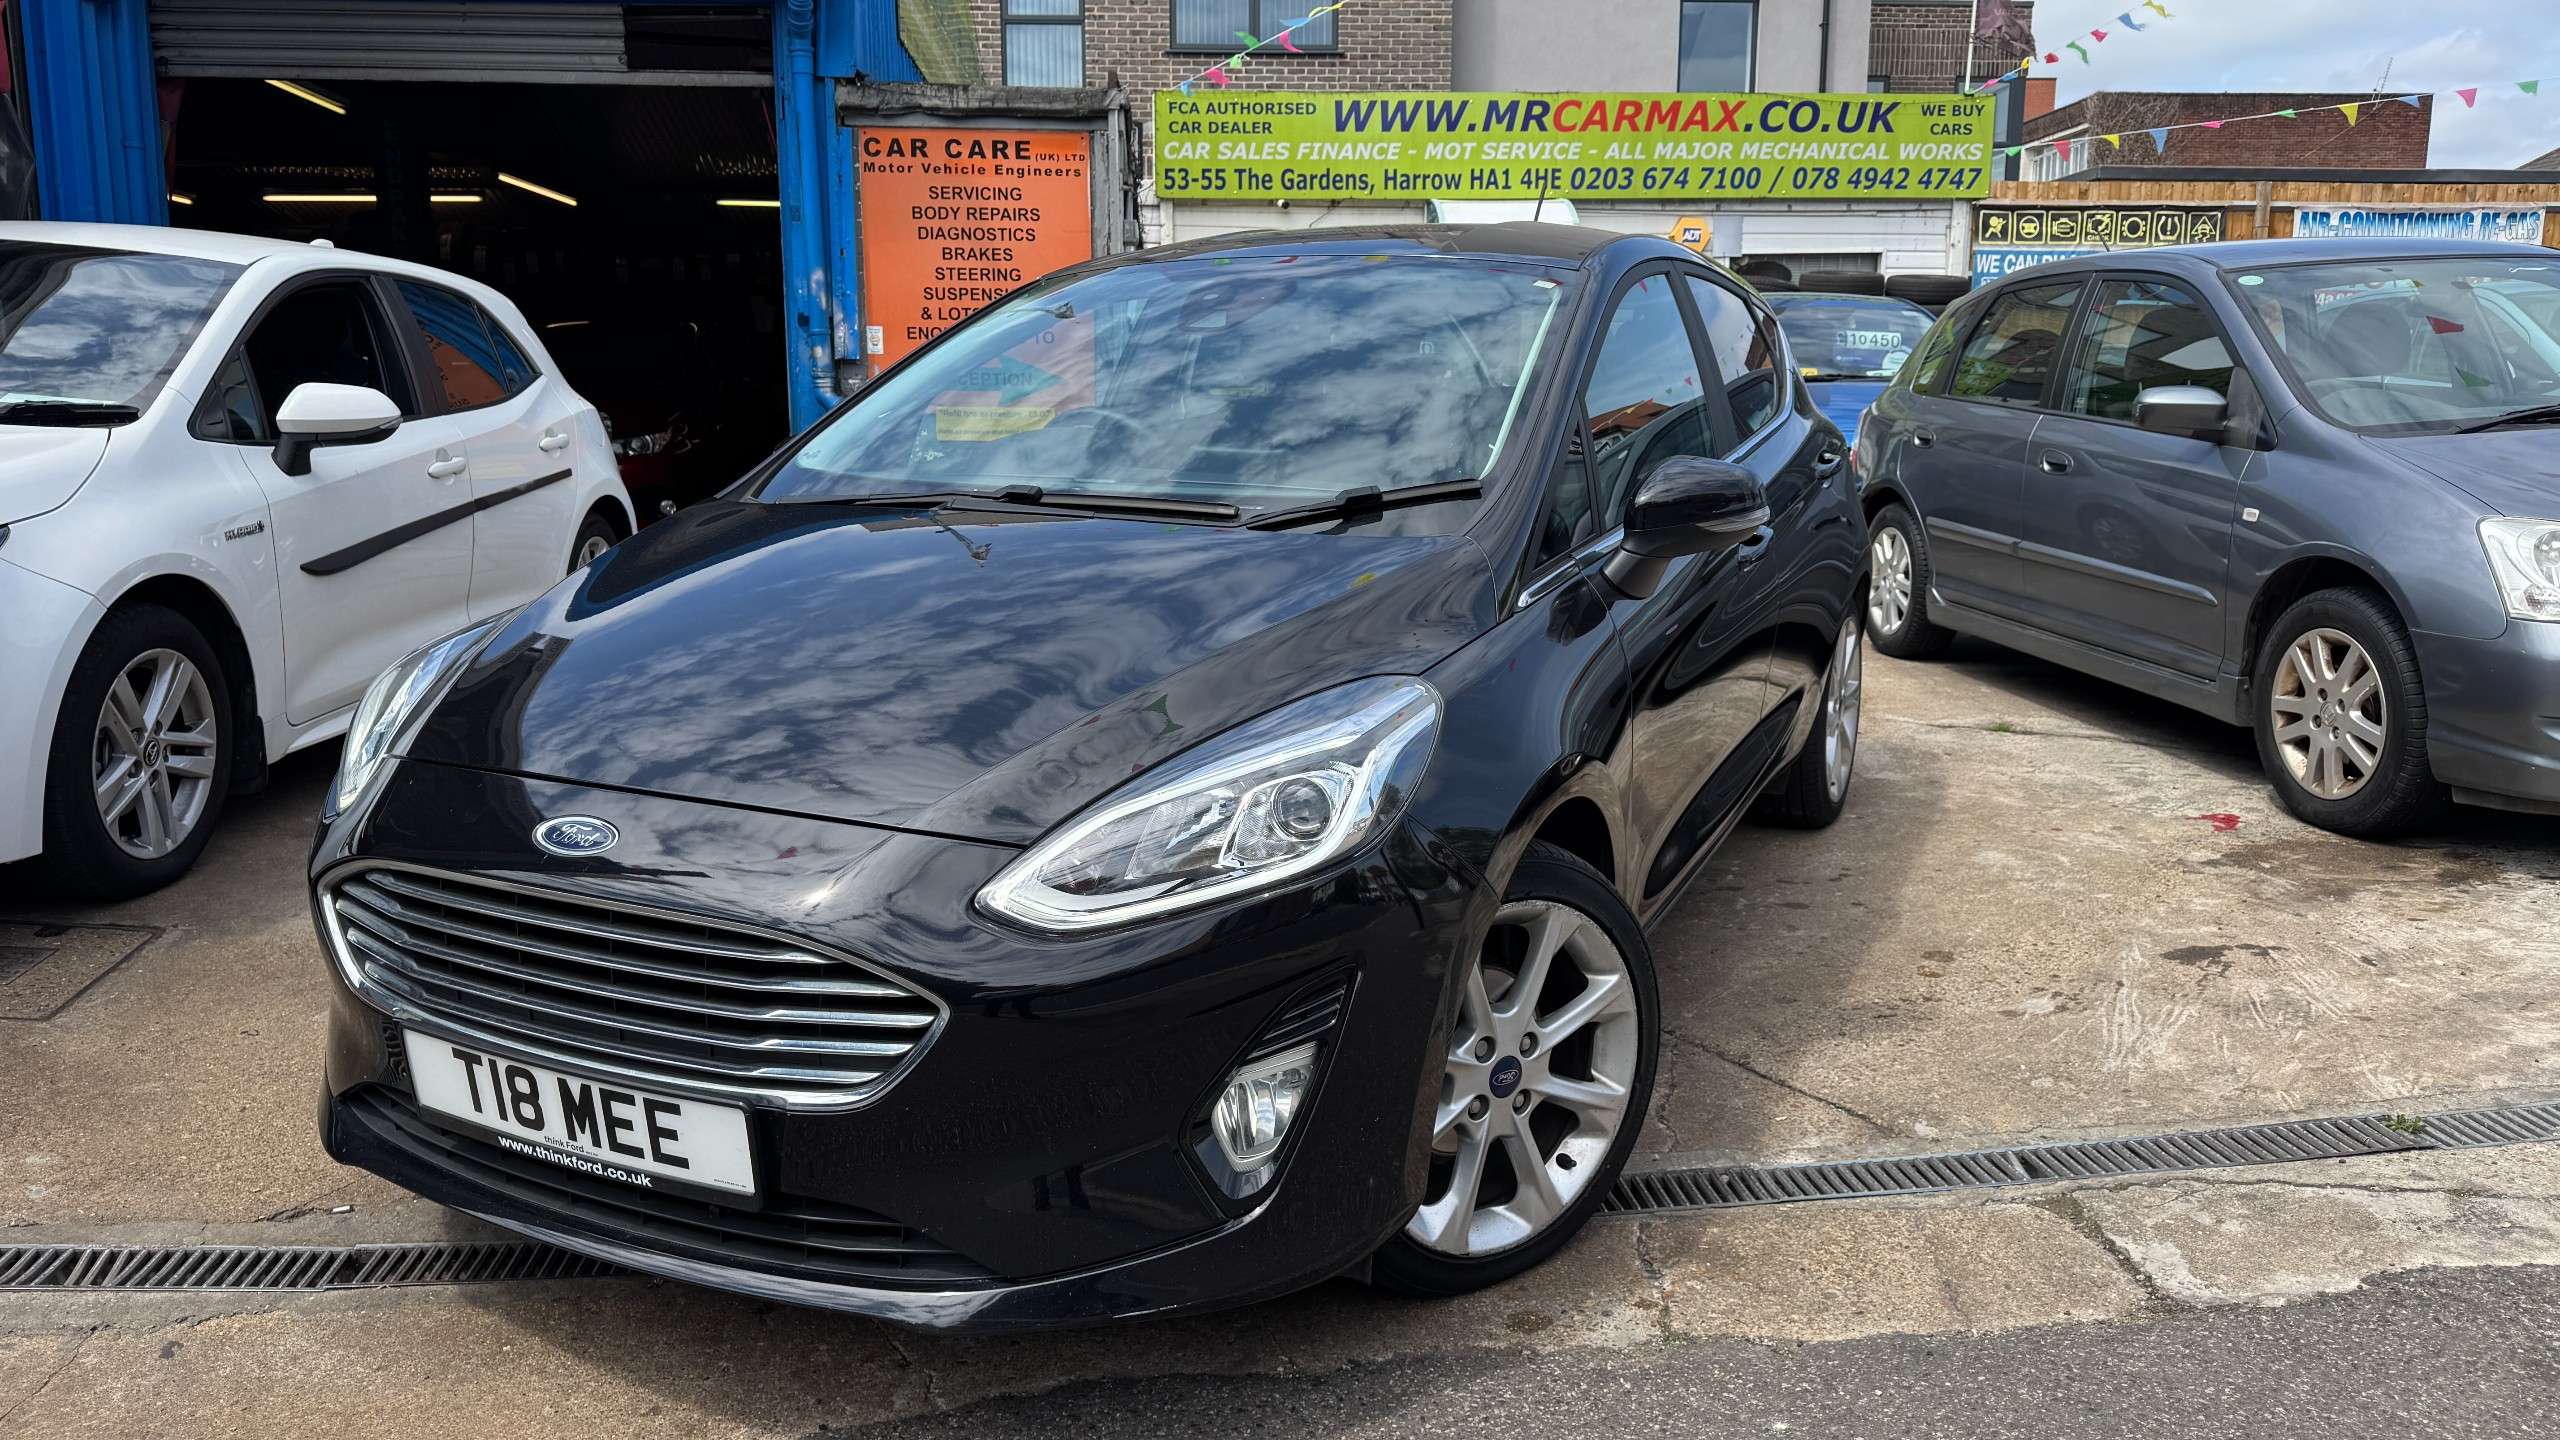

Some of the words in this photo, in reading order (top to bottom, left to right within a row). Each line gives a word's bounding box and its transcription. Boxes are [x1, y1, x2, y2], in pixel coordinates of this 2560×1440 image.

[1168, 101, 1199, 115] FCA
[1205, 101, 1317, 116] AUTHORISED
[1333, 99, 1901, 134] WWW.MRCARMAX.CO.UK
[1921, 103, 1947, 117] WE
[1951, 103, 1985, 118] BUY
[1168, 120, 1203, 135] CAR
[1207, 120, 1273, 135] DEALER
[1930, 122, 1973, 136] CARS
[863, 136, 929, 158] CAR
[944, 138, 1032, 161] CARE
[1035, 153, 1060, 163] (UK)
[1065, 153, 1086, 162] LTD
[1163, 141, 1210, 161] CAR
[1216, 141, 1291, 161] SALES
[1296, 141, 1401, 161] FINANCE
[1424, 141, 1477, 161] MOT
[1481, 141, 1582, 161] SERVICE
[1604, 141, 1646, 161] ALL
[1653, 141, 1734, 161] MAJOR
[1739, 141, 1890, 161] MECHANICAL
[1900, 141, 1984, 161] WORKS
[863, 161, 913, 174] Motor
[922, 162, 986, 176] Vehicle
[994, 164, 1082, 179] Engineers
[1163, 167, 1227, 192] 53-55
[1234, 167, 1274, 192] The
[1280, 167, 1376, 195] Gardens,
[1383, 168, 1462, 191] Harrow
[1470, 167, 1512, 191] HA1
[1520, 167, 1561, 191] 4HE
[1570, 166, 1634, 191] 0203
[1642, 166, 1689, 190] 674
[1699, 167, 1762, 191] 7100
[1768, 165, 1784, 194] /
[1791, 166, 1840, 190] 078
[1846, 166, 1909, 191] 4942
[1917, 166, 1983, 191] 4747
[928, 185, 1022, 201] SERVICING
[911, 205, 961, 221] BODY
[966, 206, 1041, 222] REPAIRS
[917, 226, 1036, 242] DIAGNOSTICS
[1682, 228, 1701, 241] ADT
[2299, 211, 2475, 240] AIR-CONDITIONING
[2479, 211, 2541, 241] RE-GAS
[942, 247, 1014, 262] BRAKES
[1976, 253, 2001, 274] WE
[935, 266, 1022, 282] STEERING
[921, 306, 932, 321] &
[552, 822, 601, 848] Ford
[450, 1046, 546, 1133] T18
[556, 1076, 690, 1171] MEE
[544, 1135, 566, 1149] think
[566, 1140, 585, 1154] Ford
[497, 1134, 654, 1189] www.thinkford.co.uk
